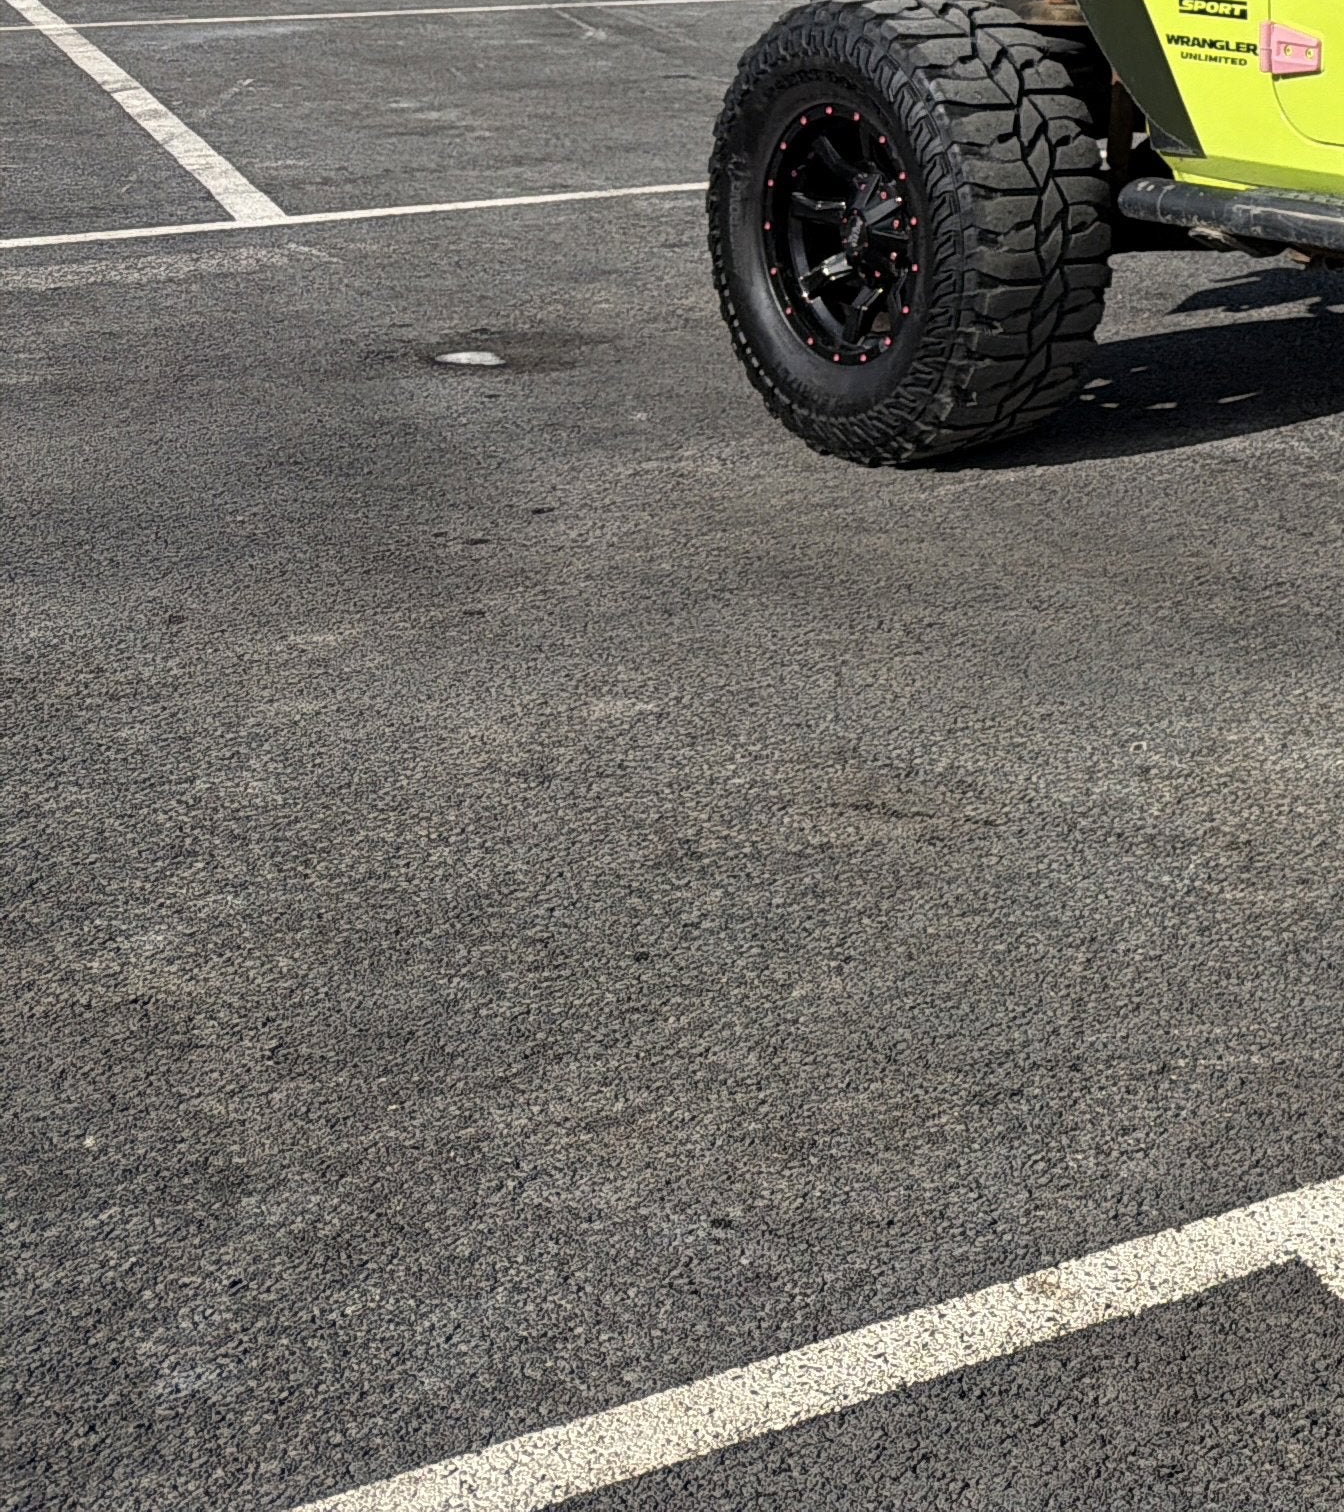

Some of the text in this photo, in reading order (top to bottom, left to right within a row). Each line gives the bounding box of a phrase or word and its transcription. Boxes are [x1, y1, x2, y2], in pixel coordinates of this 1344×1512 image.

[1182, 0, 1244, 16] SPORT
[1166, 34, 1258, 56] WRANGLER
[1181, 51, 1247, 66] UNLIMITED
